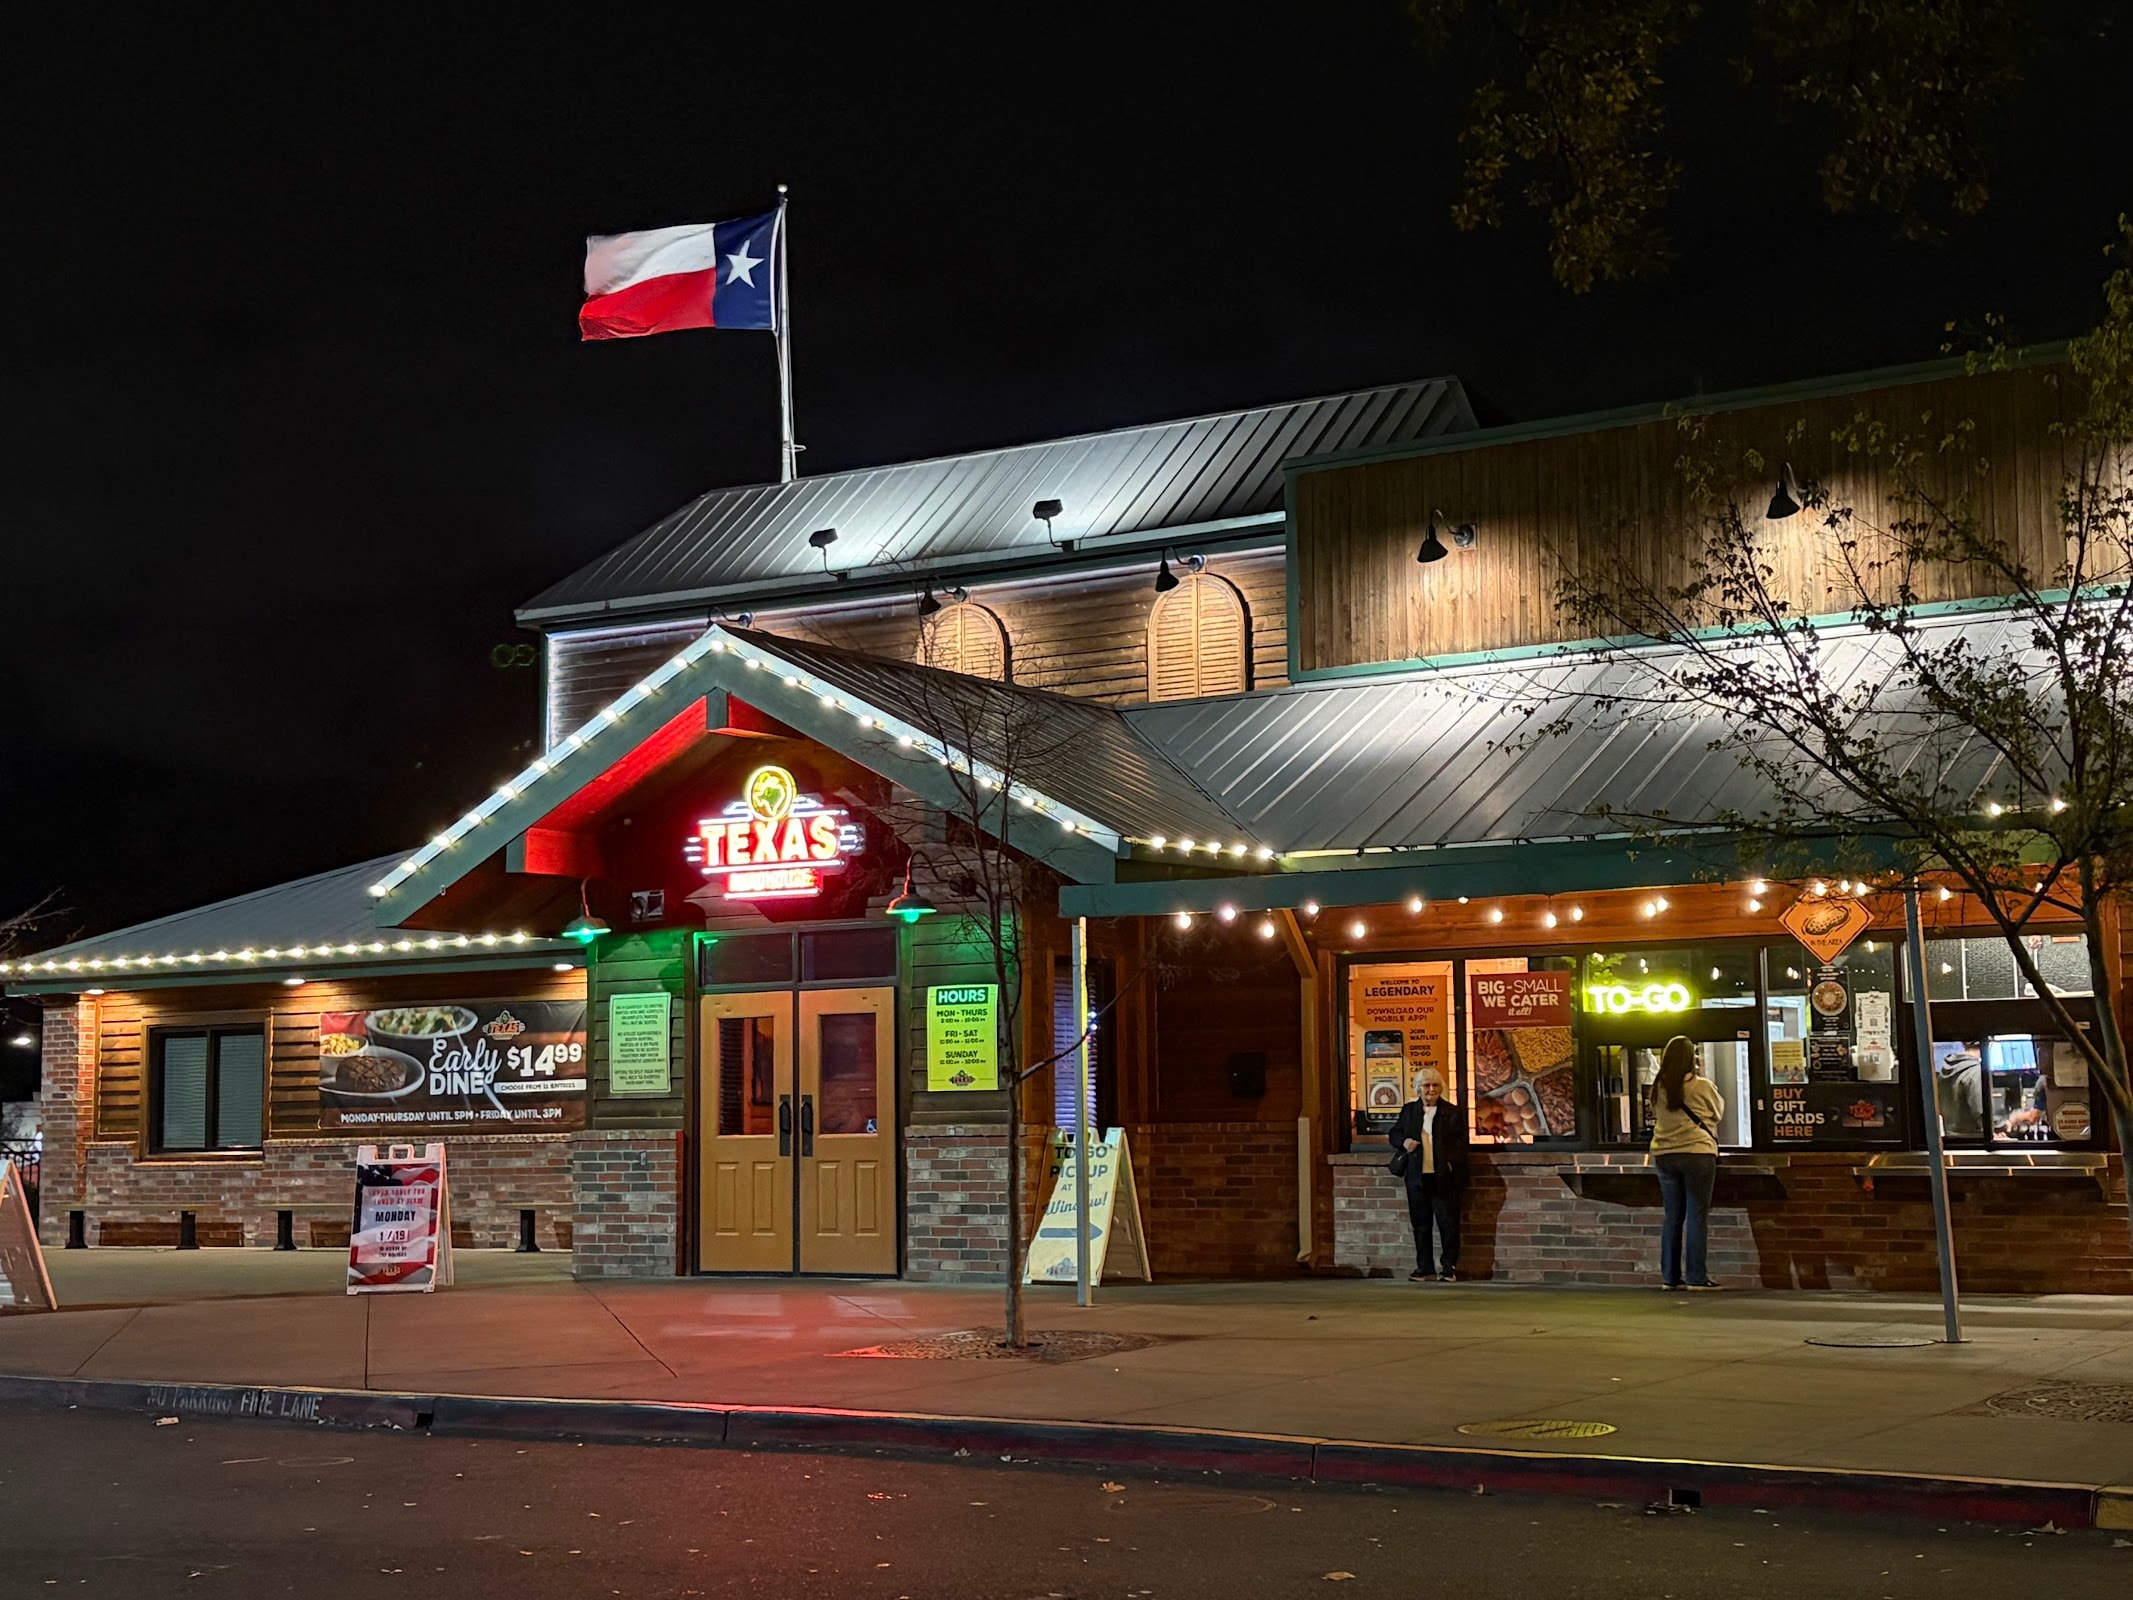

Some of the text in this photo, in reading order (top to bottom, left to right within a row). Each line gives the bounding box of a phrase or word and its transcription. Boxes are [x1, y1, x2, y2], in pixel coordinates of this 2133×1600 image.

[700, 814, 839, 867] TEXAS
[938, 989, 986, 1003] HOURS
[1365, 985, 1435, 997] LEGENDARY
[1482, 993, 1559, 1008] WE CATER
[1588, 983, 1690, 1014] TO-GO
[490, 1022, 519, 1034] TEXAS
[945, 1050, 978, 1058] SUNDAY
[429, 1038, 502, 1084] Early
[429, 1072, 485, 1096] DINE
[1773, 1088, 1803, 1099] BUY
[1773, 1101, 1806, 1112] GIFT
[341, 1107, 562, 1123] MONDAY-THURSDAY UNTIL 5PM FRIDAY UNTIL 3PM
[1774, 1113, 1825, 1124] CARDS
[1774, 1126, 1813, 1137] HERE
[1050, 1165, 1108, 1178] PICUP
[375, 1211, 416, 1222] MONDAY
[280, 1395, 323, 1420] LANE
